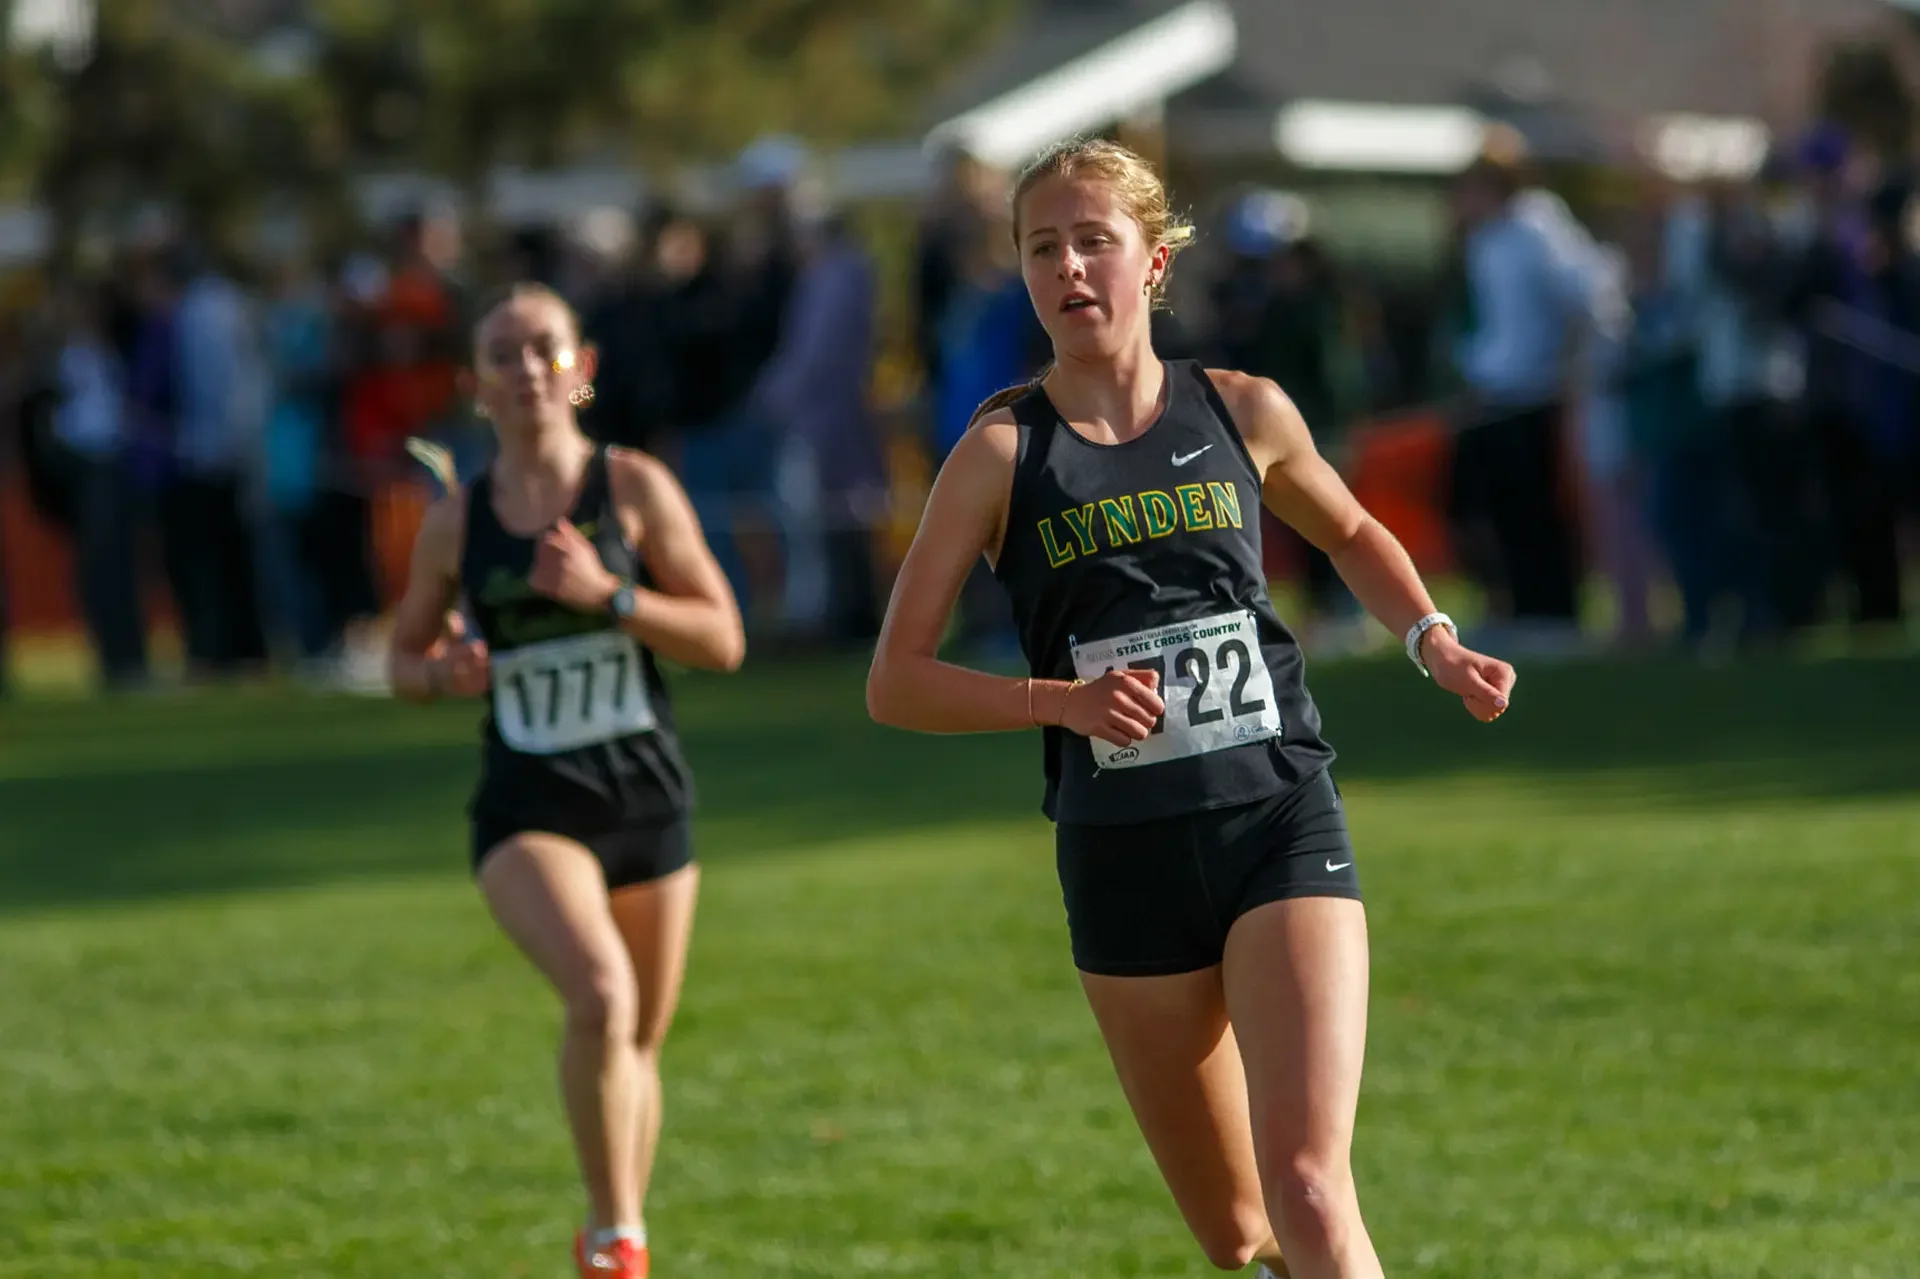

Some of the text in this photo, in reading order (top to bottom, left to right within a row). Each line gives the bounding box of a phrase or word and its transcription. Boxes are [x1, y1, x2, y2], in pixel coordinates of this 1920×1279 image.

[1037, 480, 1243, 568] LYNDEN
[1116, 641, 1151, 657] STATE
[1154, 632, 1190, 649] CROSS
[1193, 622, 1242, 641] COUNTRY
[507, 653, 627, 729] 1777
[1105, 638, 1267, 735] 722
